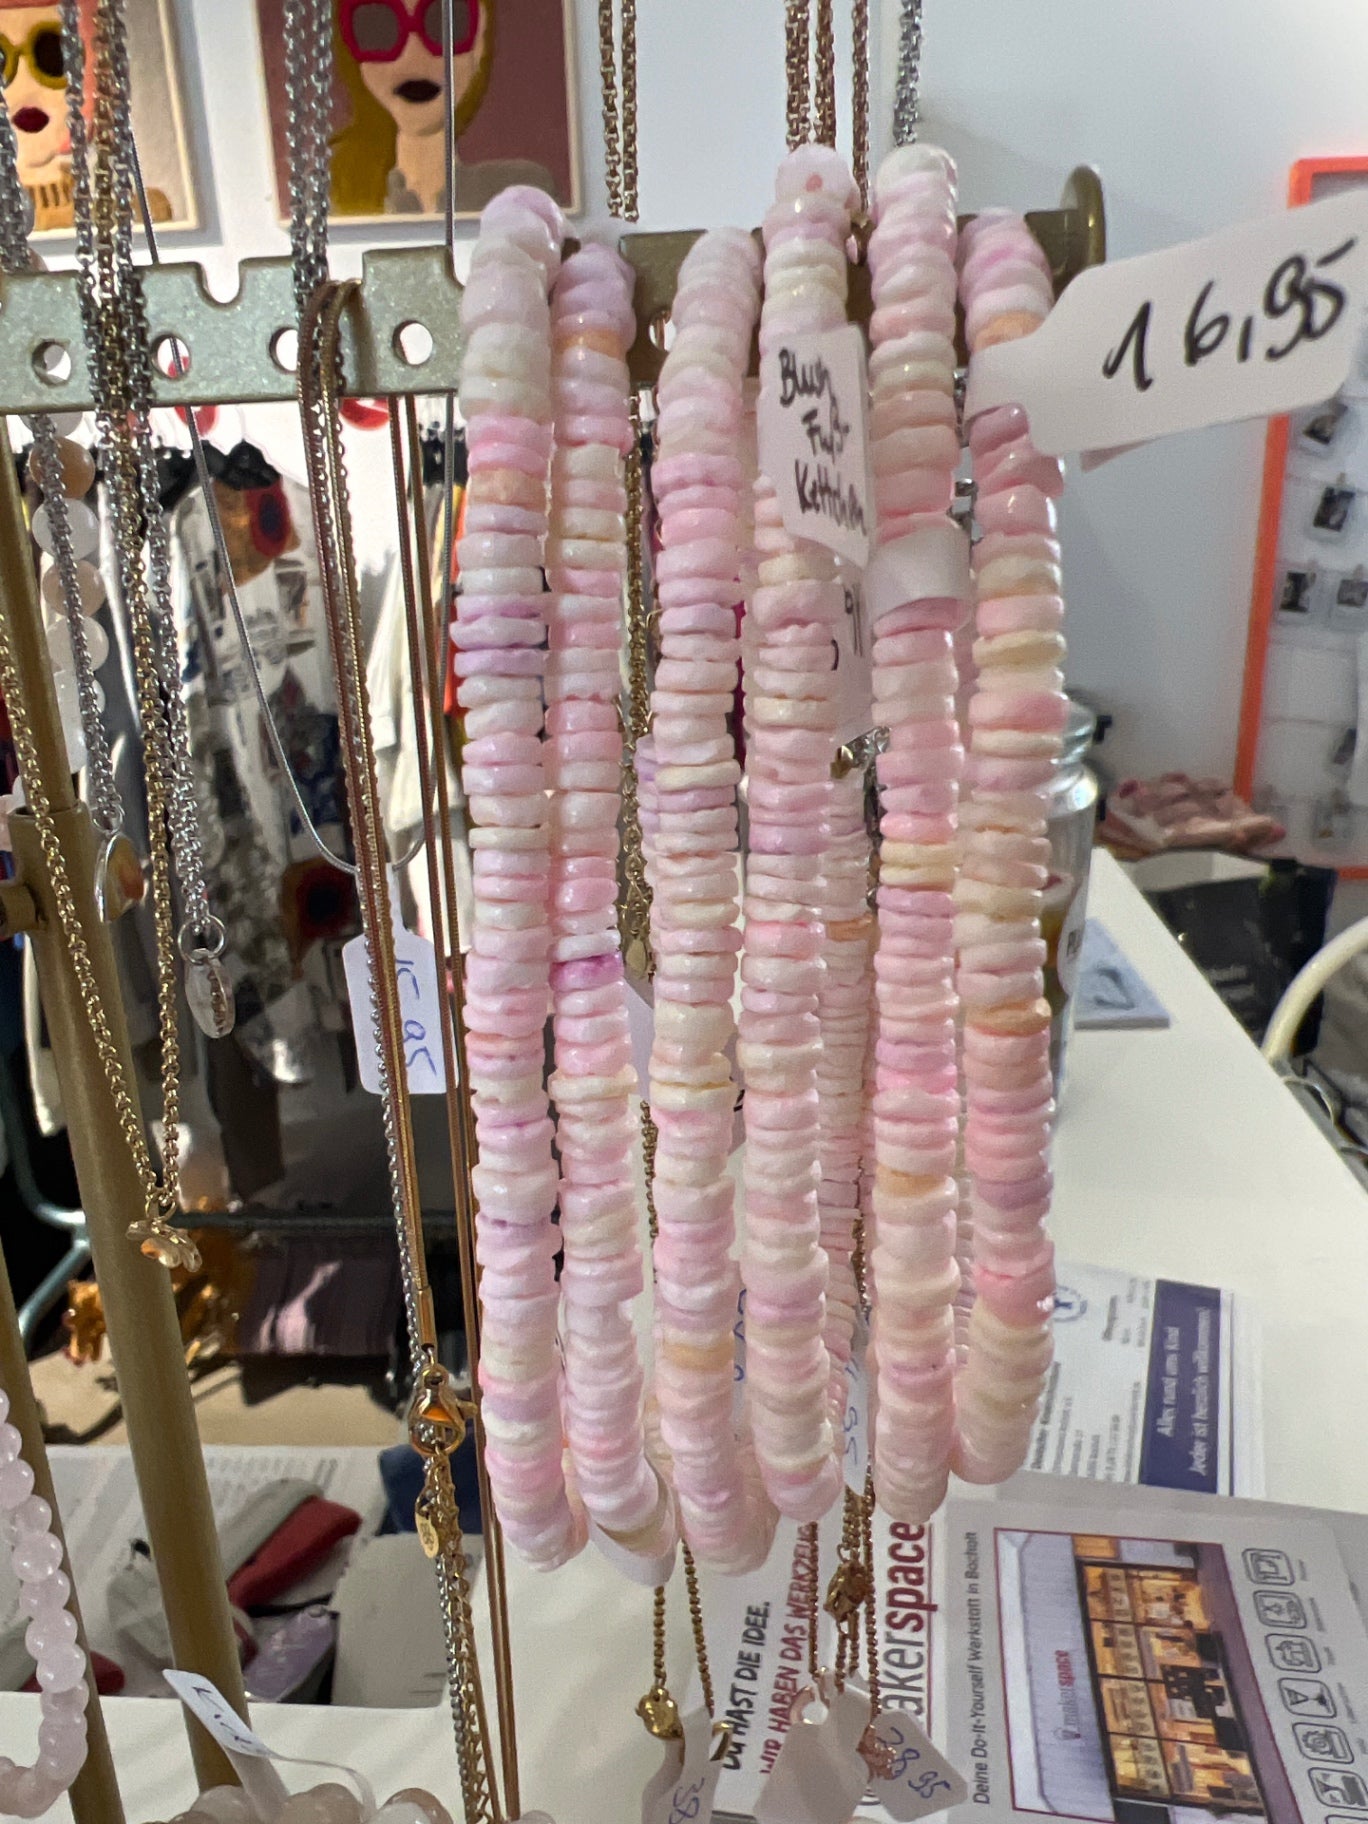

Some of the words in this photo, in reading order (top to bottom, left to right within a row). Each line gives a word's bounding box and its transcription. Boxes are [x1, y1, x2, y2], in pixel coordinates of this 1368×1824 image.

[1103, 236, 1355, 391] 16,95
[963, 1532, 980, 1579] Bocholt
[741, 1600, 770, 1647] IDEE.
[778, 1622, 808, 1662] DAS
[881, 1521, 938, 1717] akerspace
[967, 1598, 983, 1661] Werkstatt
[734, 1650, 761, 1681] DIE
[724, 1683, 758, 1736] HAST
[767, 1665, 800, 1735] HABEN
[967, 1664, 988, 1758] Do-It-Yourself
[973, 1762, 990, 1804] Deine
